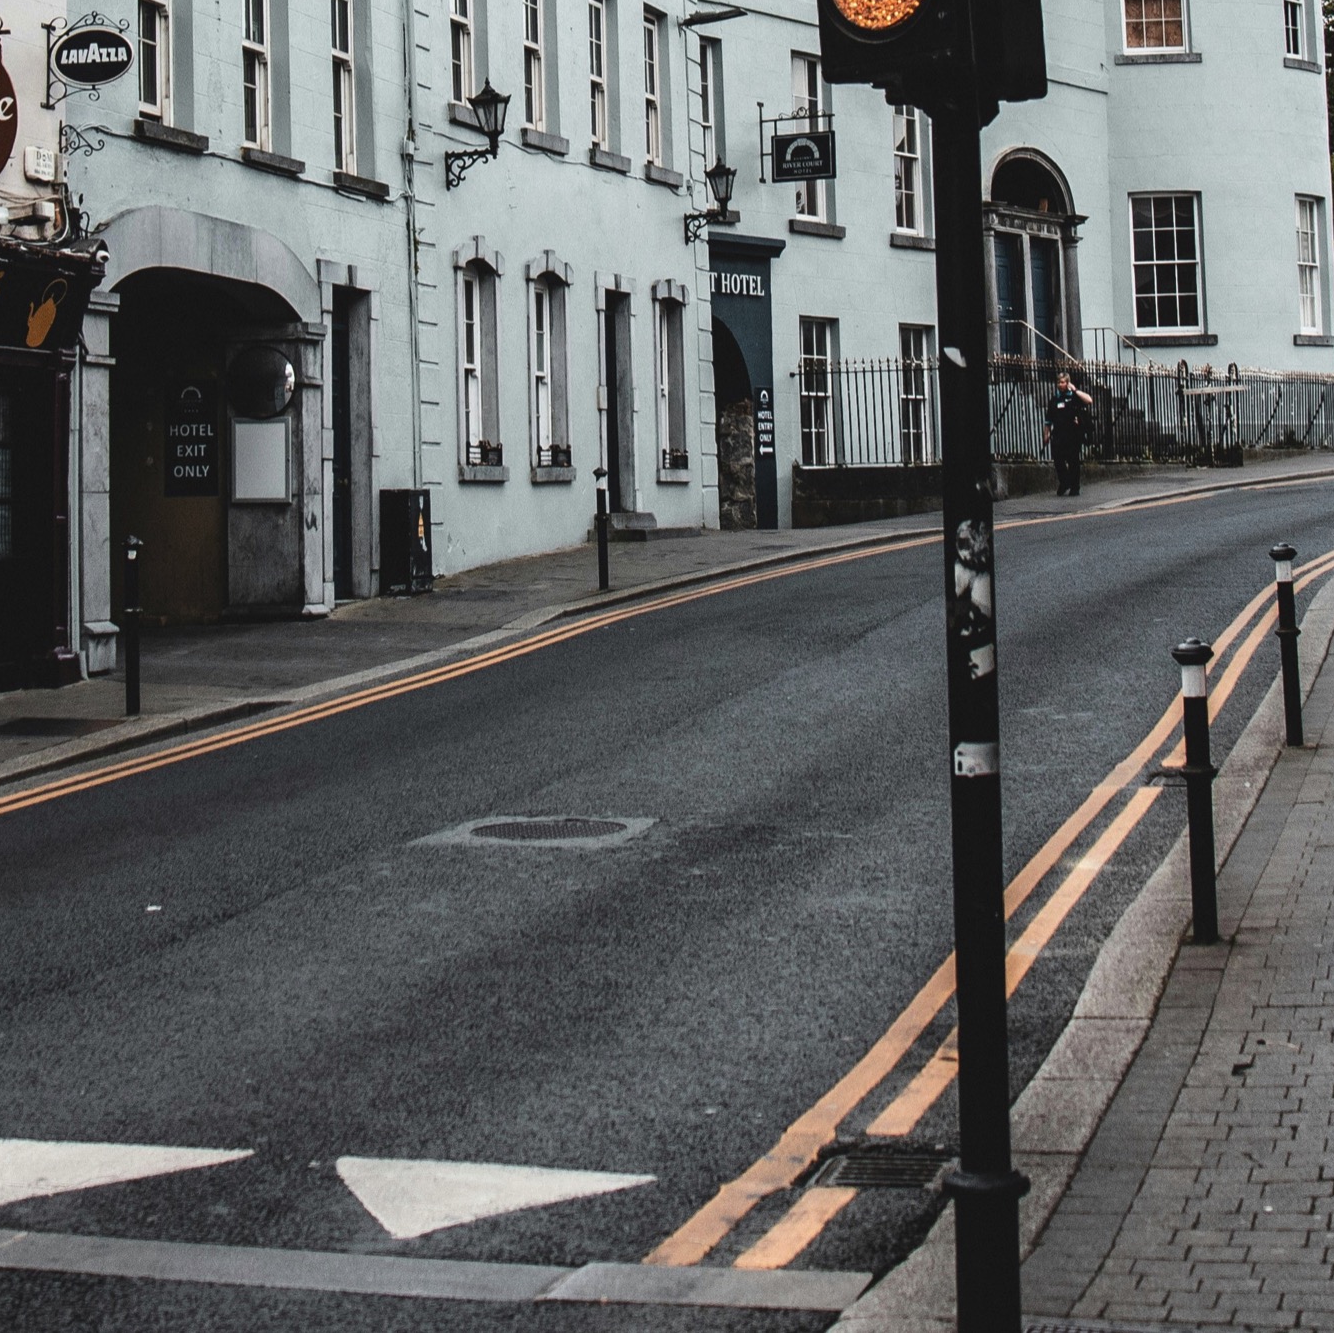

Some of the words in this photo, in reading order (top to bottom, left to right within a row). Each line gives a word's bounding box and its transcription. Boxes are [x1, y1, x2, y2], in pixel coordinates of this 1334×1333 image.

[60, 42, 128, 65] LAVAZZA
[721, 272, 765, 297] HOTEL
[757, 410, 773, 420] HOTEL
[169, 424, 214, 437] HOTEL
[757, 421, 773, 432] ENTRY
[759, 432, 773, 443] ONLY
[176, 444, 207, 457] EXIT
[173, 465, 210, 478] ONLY
